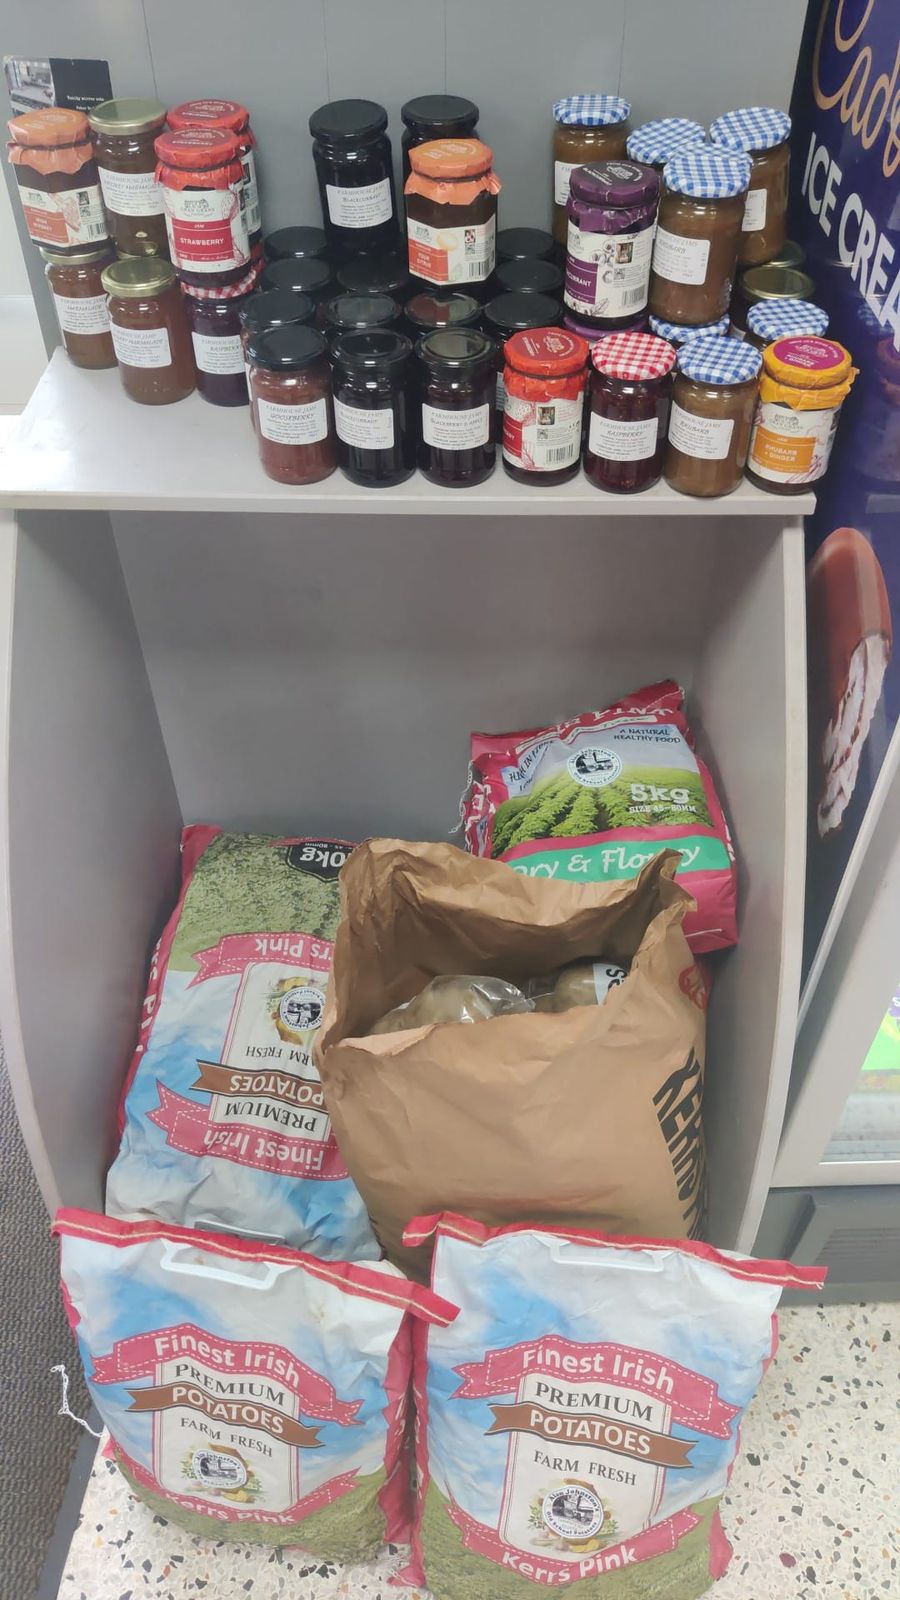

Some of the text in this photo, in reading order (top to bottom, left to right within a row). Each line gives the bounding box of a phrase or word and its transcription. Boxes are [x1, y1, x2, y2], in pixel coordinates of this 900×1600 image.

[801, 131, 843, 238] ICE
[180, 237, 224, 246] STRAWBERRY
[566, 269, 592, 287] CURRANT
[765, 444, 798, 456] RHUBARB
[769, 452, 796, 462] GINGER
[614, 734, 681, 744] HEALTHY FOOD
[523, 754, 533, 769] IN
[631, 783, 690, 804] 5kg
[629, 805, 651, 814] SIZE
[300, 847, 351, 868] 0kg
[568, 854, 591, 872] &
[255, 937, 304, 958] Pink
[246, 1045, 283, 1058] FRESH
[229, 1075, 324, 1106] POTATOES
[225, 1101, 317, 1132] PREMIUM
[203, 1129, 325, 1171] Finest Irish
[155, 1333, 300, 1388] Finest Irish
[523, 1345, 674, 1394] Finest Irish
[174, 1363, 286, 1407] PREMIUM
[171, 1386, 284, 1434] POTATOES
[535, 1381, 654, 1422] PREMIUM
[180, 1417, 273, 1457] FARM FRESH
[530, 1409, 651, 1455] POTATOES
[533, 1450, 637, 1487] FARM FRESH
[549, 1488, 600, 1512] Alan Johnston's
[501, 1544, 636, 1585] Kerrs Pink
